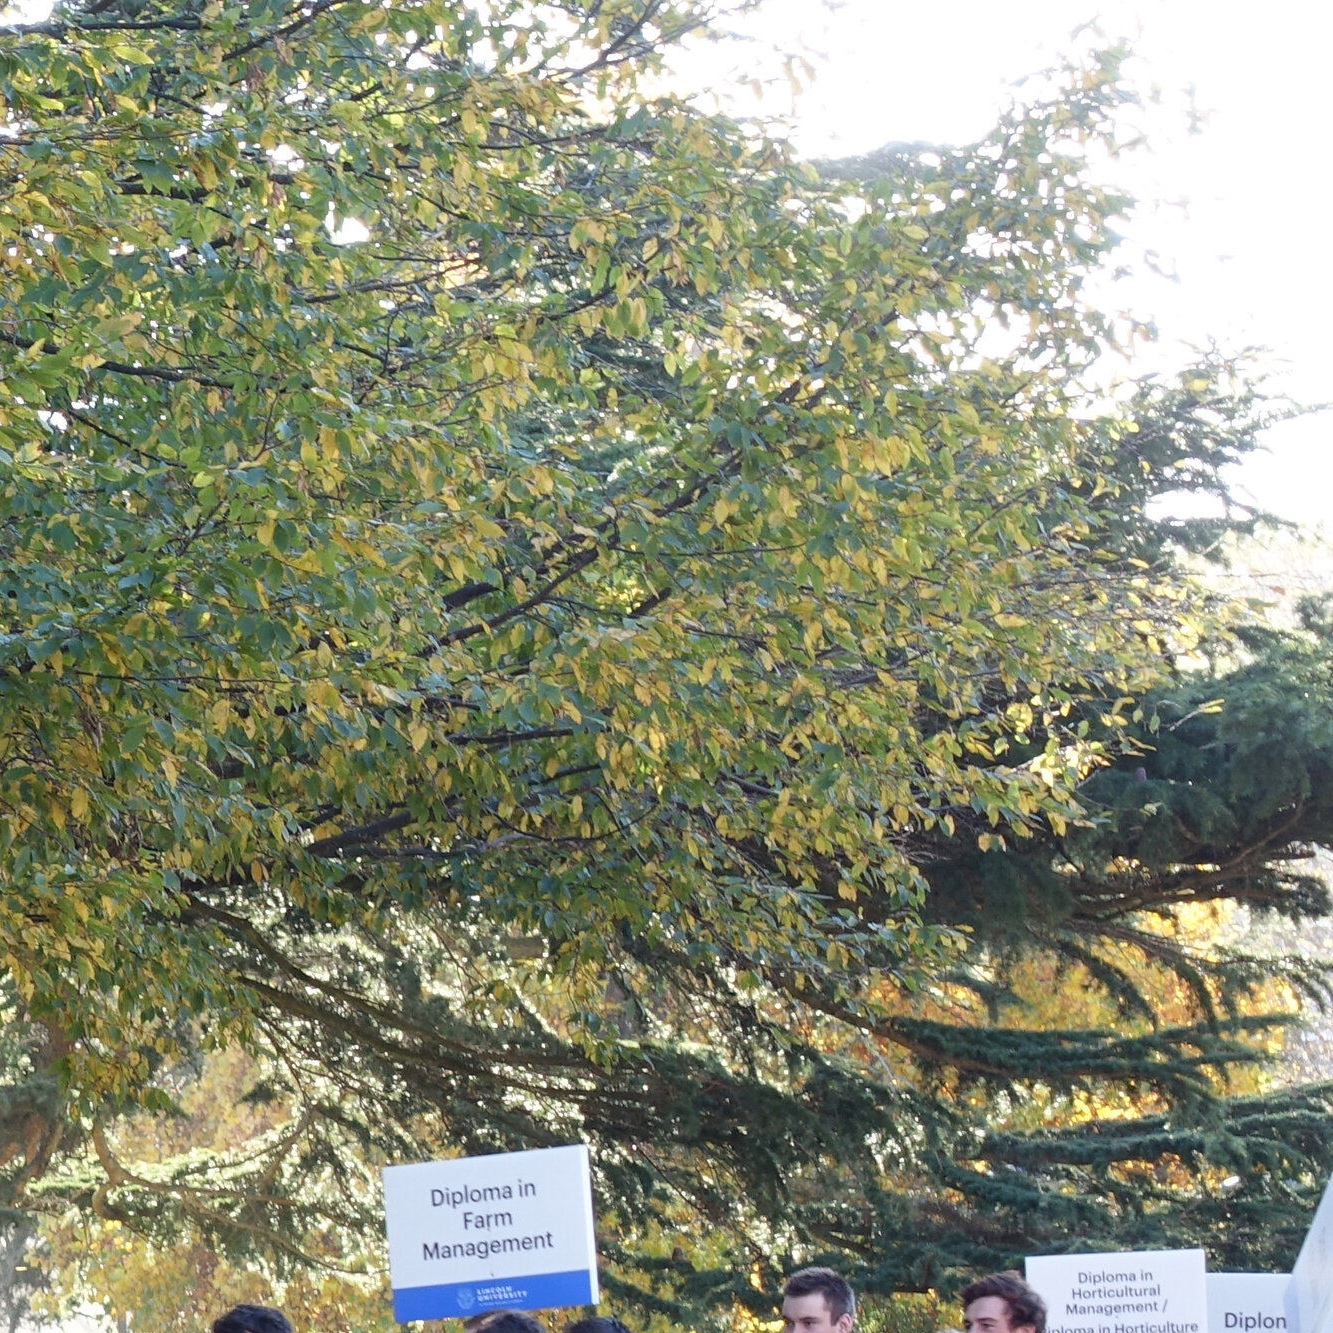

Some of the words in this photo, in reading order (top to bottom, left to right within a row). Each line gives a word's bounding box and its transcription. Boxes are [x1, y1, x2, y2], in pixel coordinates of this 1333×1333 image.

[430, 1184, 513, 1209] Diploma
[517, 1179, 537, 1198] in
[463, 1210, 513, 1230] Farm
[422, 1231, 554, 1261] Management
[1077, 1270, 1136, 1285] Diploma
[1140, 1269, 1153, 1281] in
[1071, 1284, 1161, 1300] Horticultural
[1065, 1302, 1159, 1317] Management
